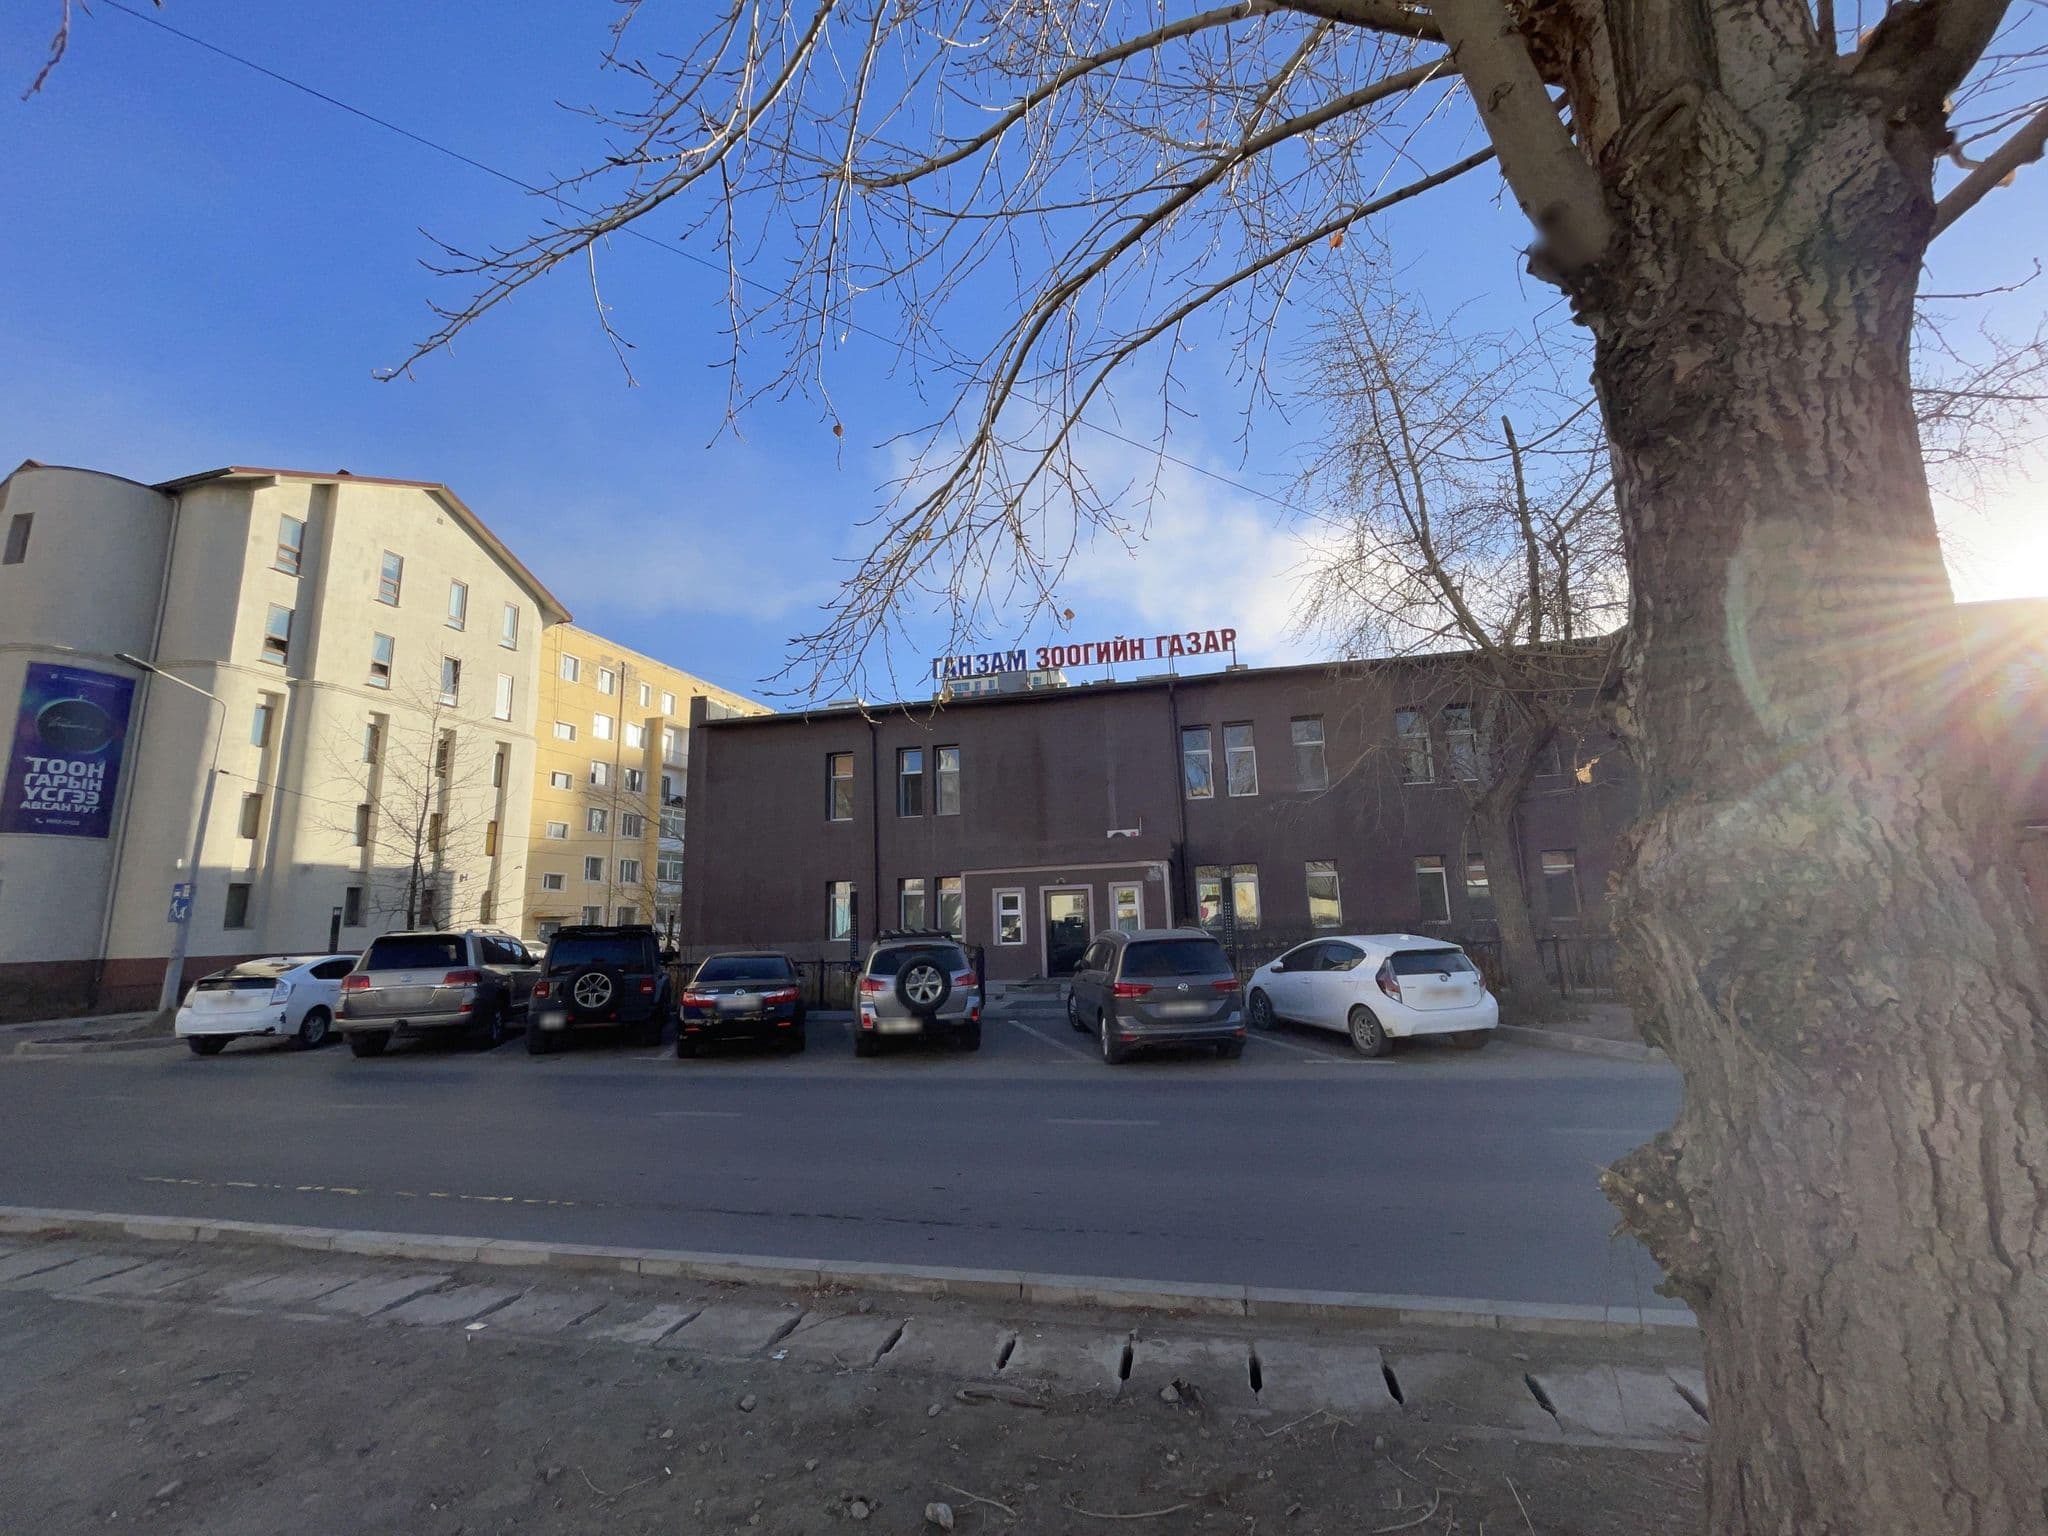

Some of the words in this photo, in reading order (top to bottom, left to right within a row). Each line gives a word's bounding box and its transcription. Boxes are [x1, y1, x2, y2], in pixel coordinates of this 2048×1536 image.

[932, 649, 1028, 679] ГАНЗАМ
[1036, 635, 1144, 668] ЗООГИЙН
[1156, 628, 1236, 658] ГАЗАР
[24, 757, 106, 778] ТООН
[24, 773, 102, 791] ГАРЫН
[20, 801, 71, 812] АВСАН
